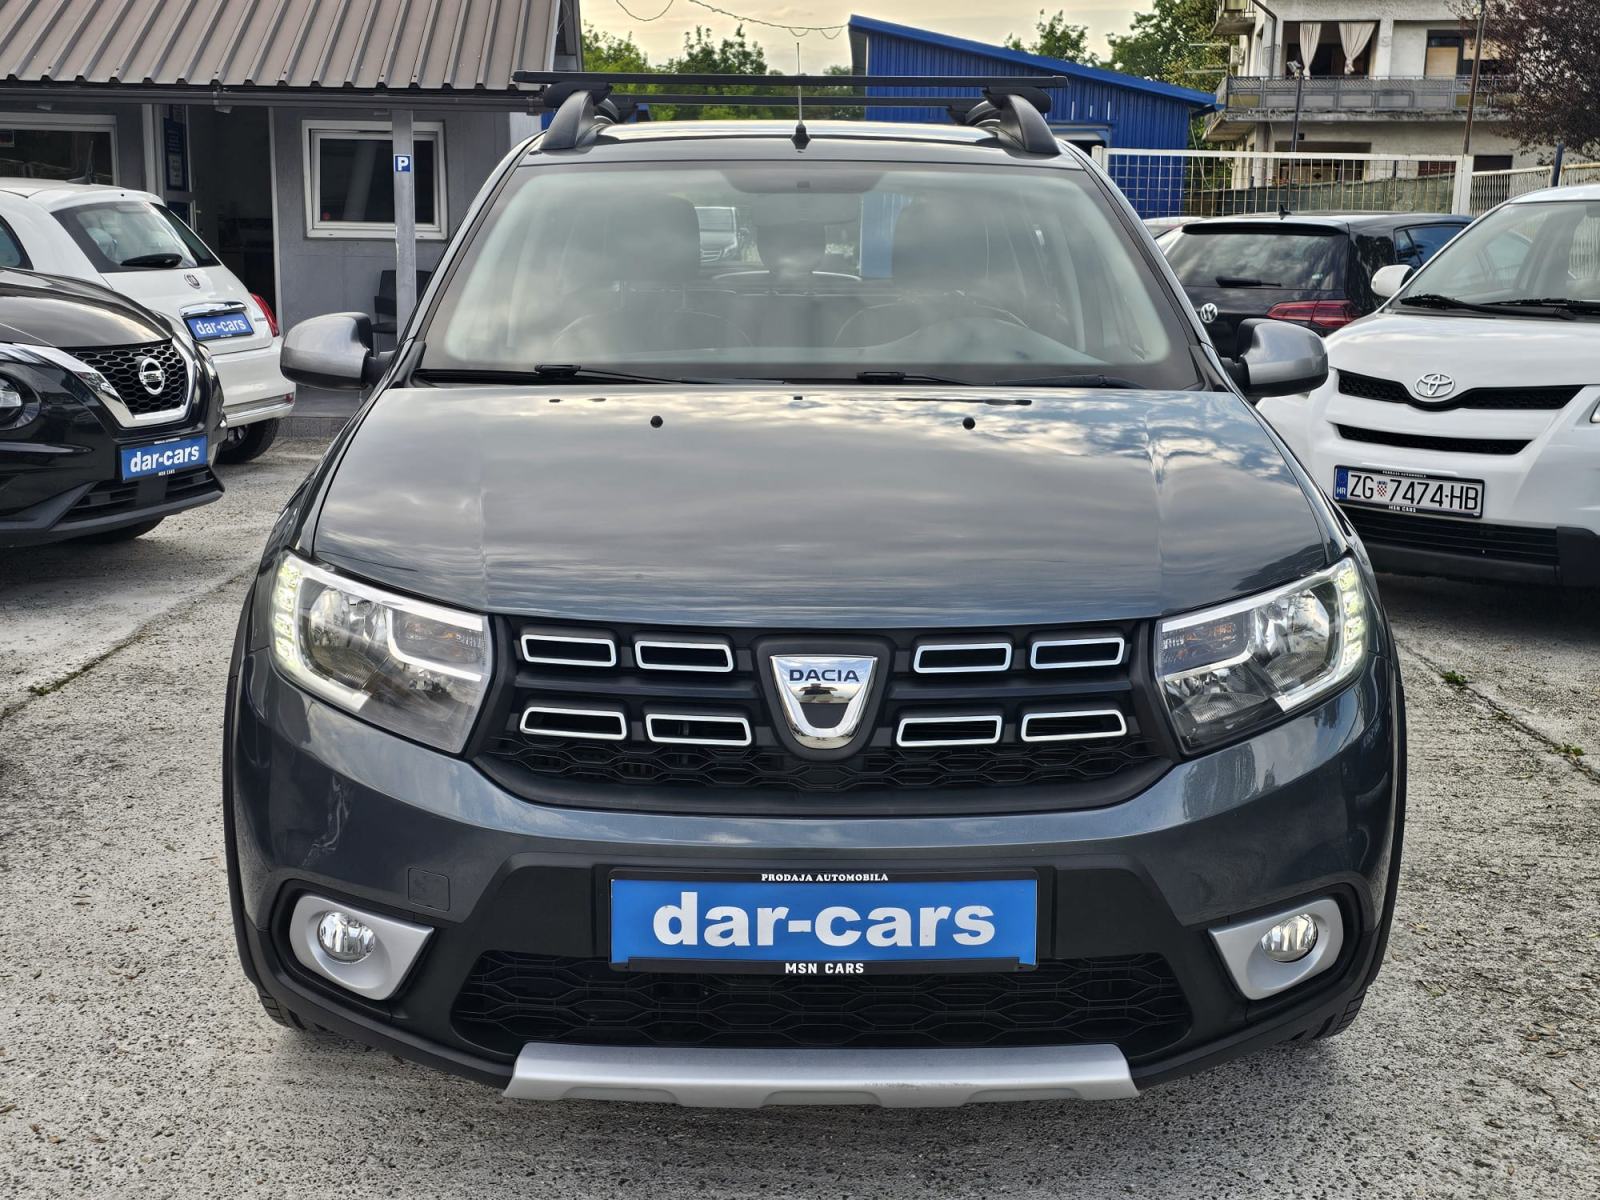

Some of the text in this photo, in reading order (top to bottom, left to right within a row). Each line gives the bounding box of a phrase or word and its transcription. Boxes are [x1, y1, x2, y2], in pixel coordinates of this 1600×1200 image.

[397, 156, 409, 171] P
[196, 320, 247, 335] dar-cars
[130, 445, 199, 473] dar-cars
[1350, 474, 1374, 500] ZG
[789, 669, 860, 682] DACIA
[761, 873, 889, 881] PRODAJA AUTOMOBILA
[653, 891, 995, 947] dar-cars
[785, 962, 864, 974] MSN CARS
